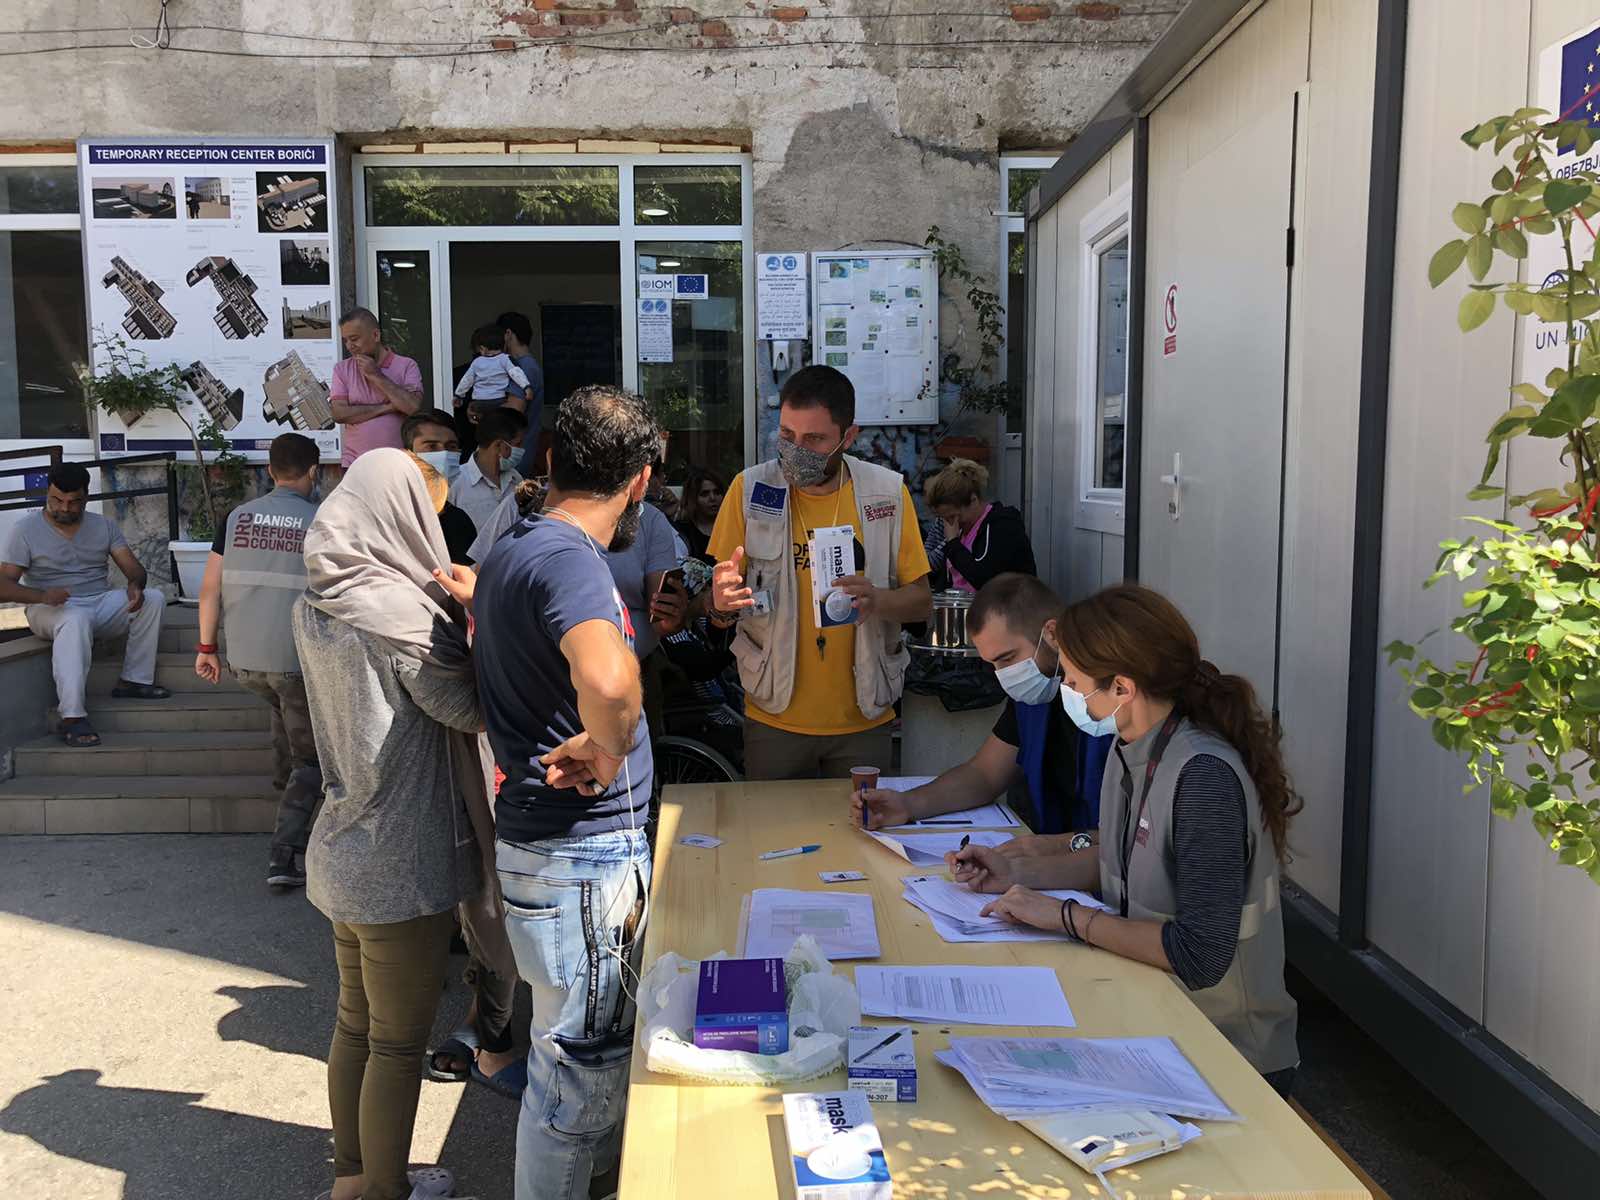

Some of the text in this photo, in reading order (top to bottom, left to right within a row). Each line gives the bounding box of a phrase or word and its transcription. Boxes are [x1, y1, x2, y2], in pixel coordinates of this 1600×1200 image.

[95, 149, 164, 160] TEMPORARY
[166, 149, 228, 160] RECEPTION
[231, 149, 275, 160] CENTER
[651, 280, 672, 289] IOM
[1536, 329, 1558, 350] UN
[254, 513, 303, 529] DANISH
[233, 512, 253, 548] DRC
[250, 537, 304, 553] COUNCIL
[825, 1097, 853, 1134] mask
